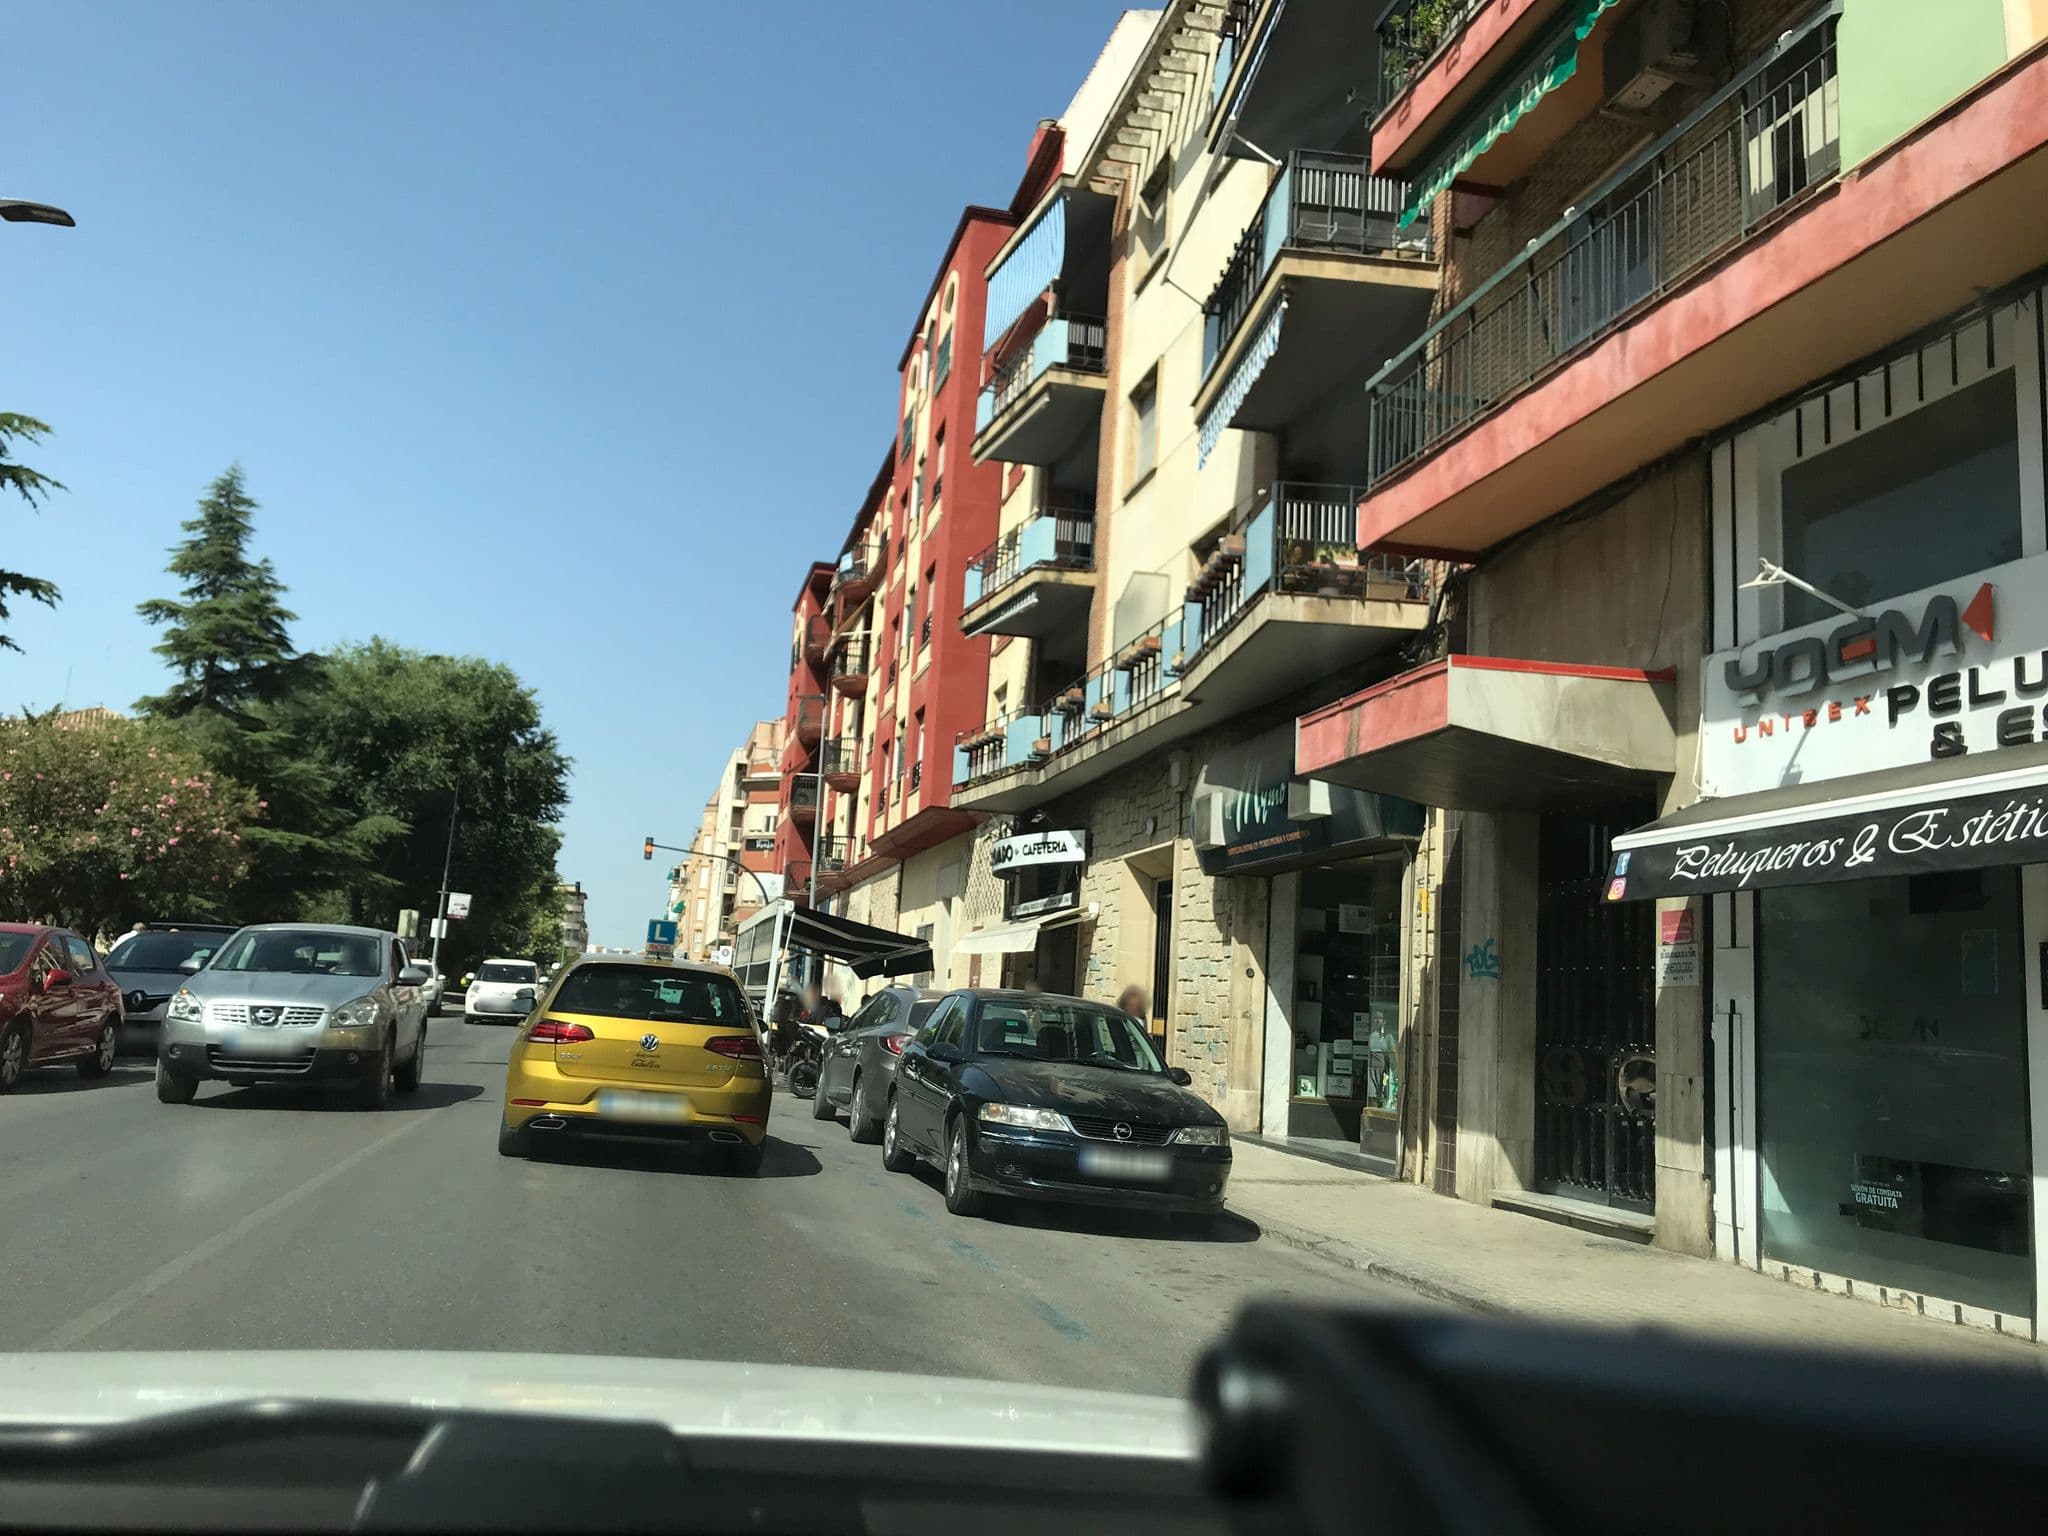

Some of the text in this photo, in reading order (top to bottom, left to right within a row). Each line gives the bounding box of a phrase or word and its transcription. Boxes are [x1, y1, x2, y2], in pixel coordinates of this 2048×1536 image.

[1517, 55, 1557, 114] PAZ
[1733, 694, 1872, 744] UNISEX
[1931, 705, 2048, 759] & E
[1669, 838, 1845, 888] Peluqueros
[1844, 823, 1880, 868] &
[654, 923, 668, 942] L
[1855, 1192, 1898, 1209] GRATUITA
[1868, 1186, 1877, 1194] DE
